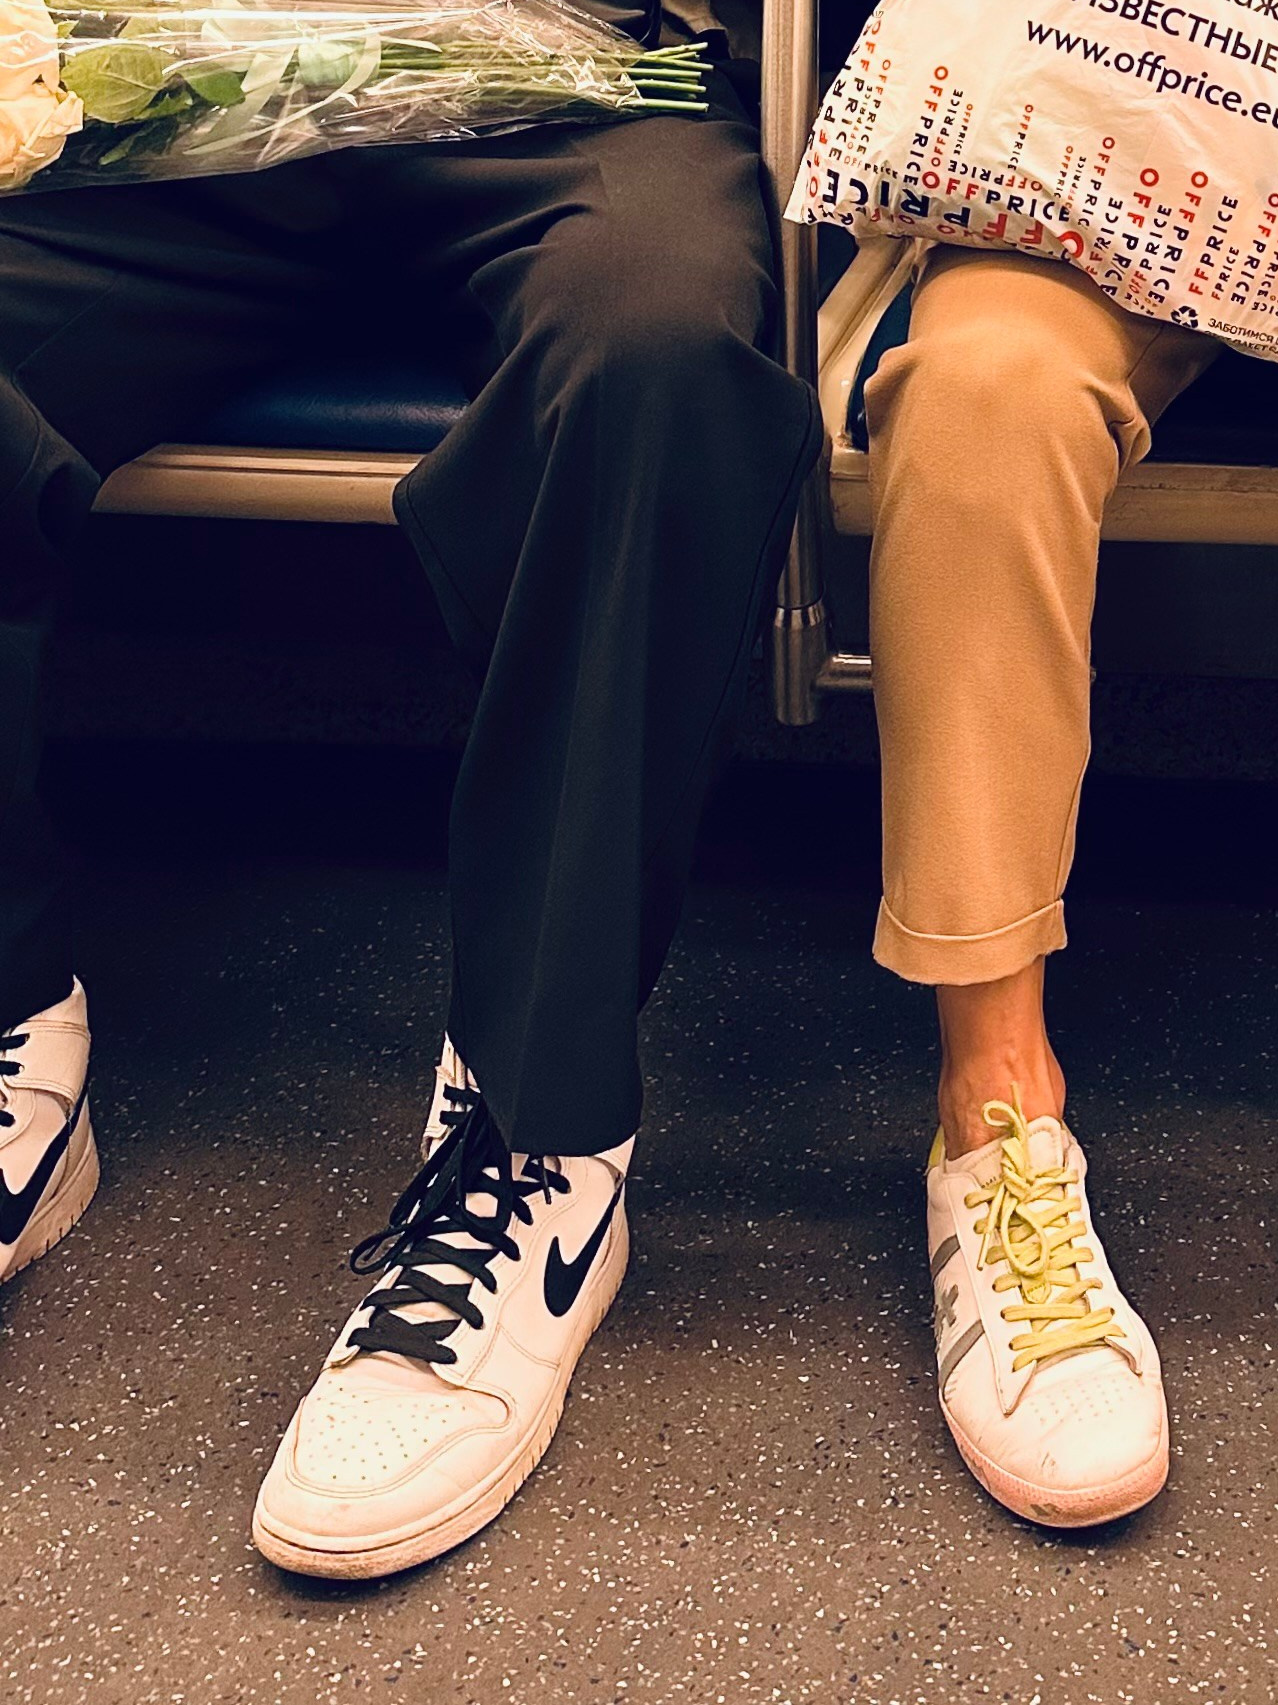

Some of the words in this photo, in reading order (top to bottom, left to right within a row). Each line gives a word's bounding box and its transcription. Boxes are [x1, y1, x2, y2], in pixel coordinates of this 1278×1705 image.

[903, 66, 949, 187] OFFPRICE
[931, 89, 964, 167] OFFPRICE
[1007, 104, 1034, 171] OFFPRICE
[921, 171, 1070, 223] OFFPRICE
[1053, 146, 1074, 199] OFFPRIC
[1078, 137, 1116, 228] OFFPRIC
[1148, 171, 1209, 304] OFFPRICE
[1207, 318, 1275, 344] ЗАБОТИМСЯ
